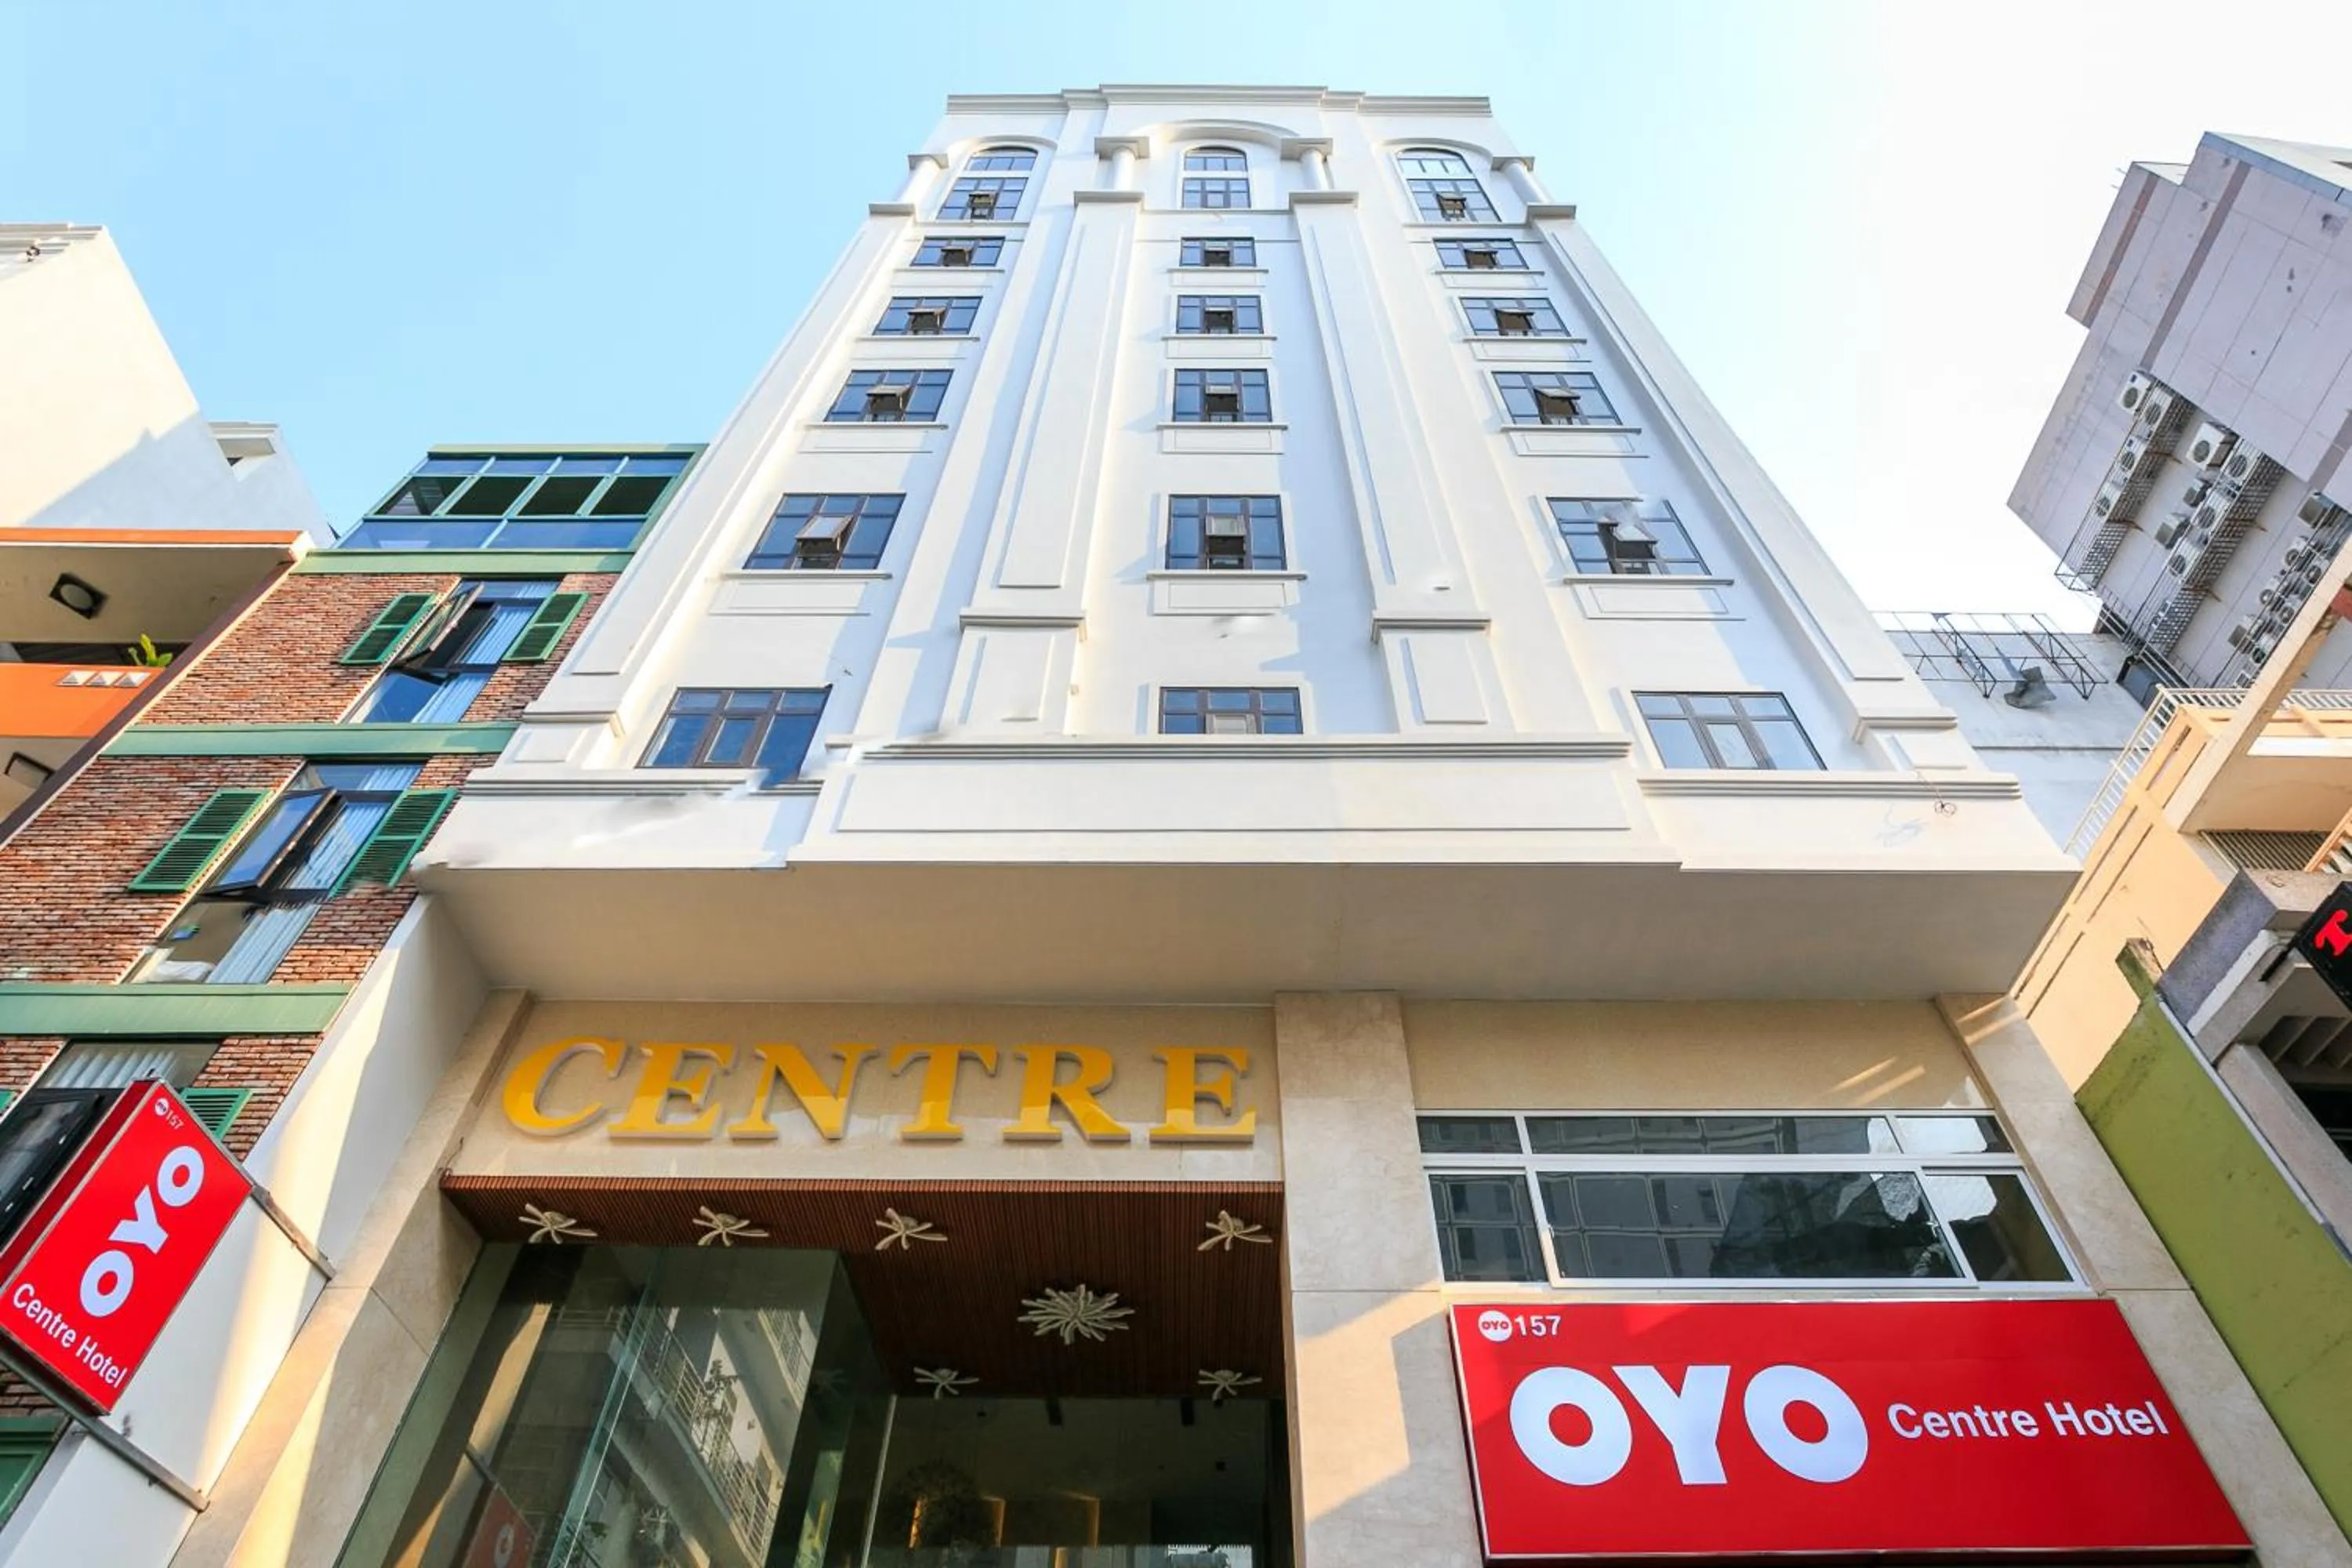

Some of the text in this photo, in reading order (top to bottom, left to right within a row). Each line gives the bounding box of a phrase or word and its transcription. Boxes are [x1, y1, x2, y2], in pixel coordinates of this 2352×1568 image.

[165, 1109, 184, 1129] 157
[501, 1035, 1255, 1140] CENTRE
[80, 1145, 205, 1317] OYO
[13, 1283, 128, 1388] Centre Hotel
[1514, 1315, 1561, 1337] 157
[1509, 1364, 2169, 1486] OYO Centre Hotel
